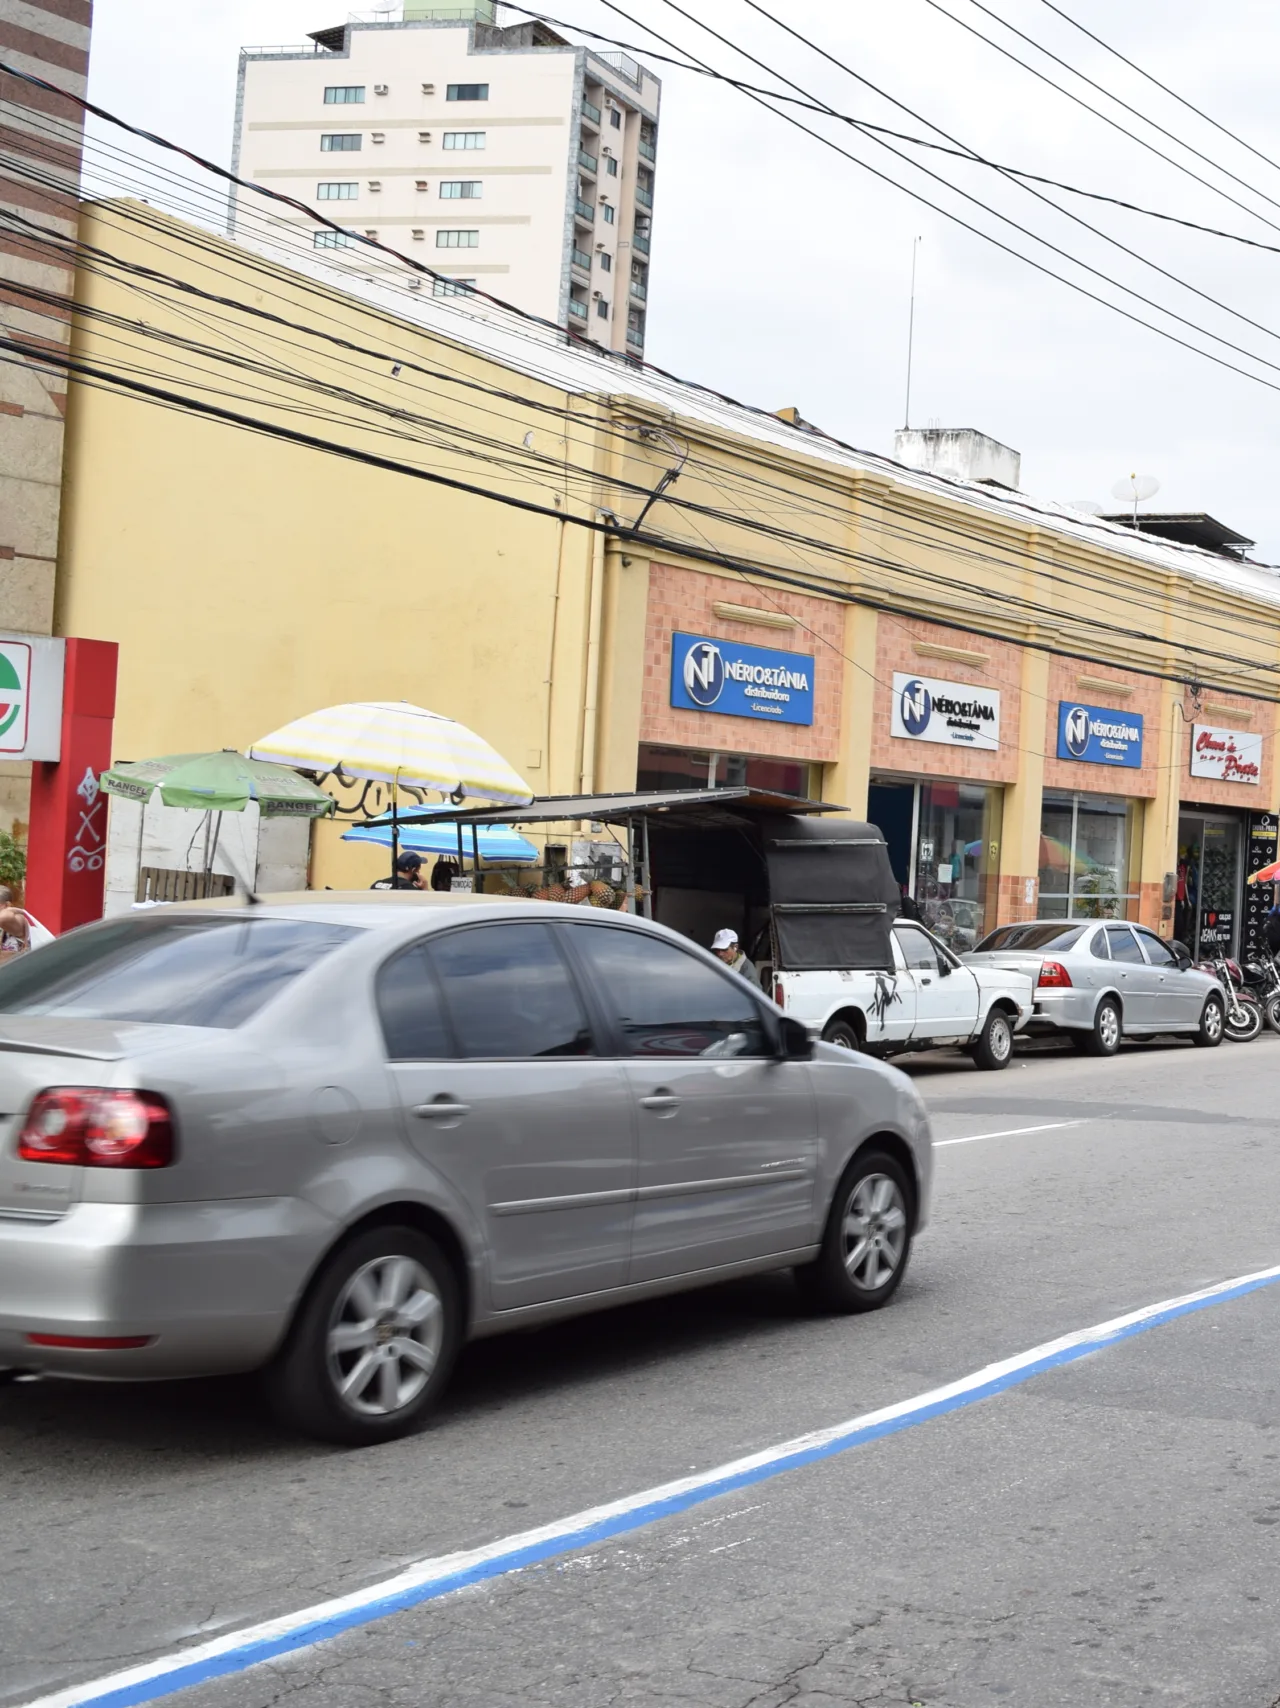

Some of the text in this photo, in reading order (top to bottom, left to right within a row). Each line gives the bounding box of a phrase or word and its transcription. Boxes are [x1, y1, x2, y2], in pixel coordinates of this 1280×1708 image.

[725, 660, 809, 691] NÉRIO&TÂNIA
[744, 685, 790, 702] distribuidora
[932, 695, 995, 721] NÉRIO&TÂNIA
[1089, 719, 1140, 742] NÉRIO&TÂNIA
[107, 778, 149, 796] RANGEL
[267, 799, 323, 812] RANGEL
